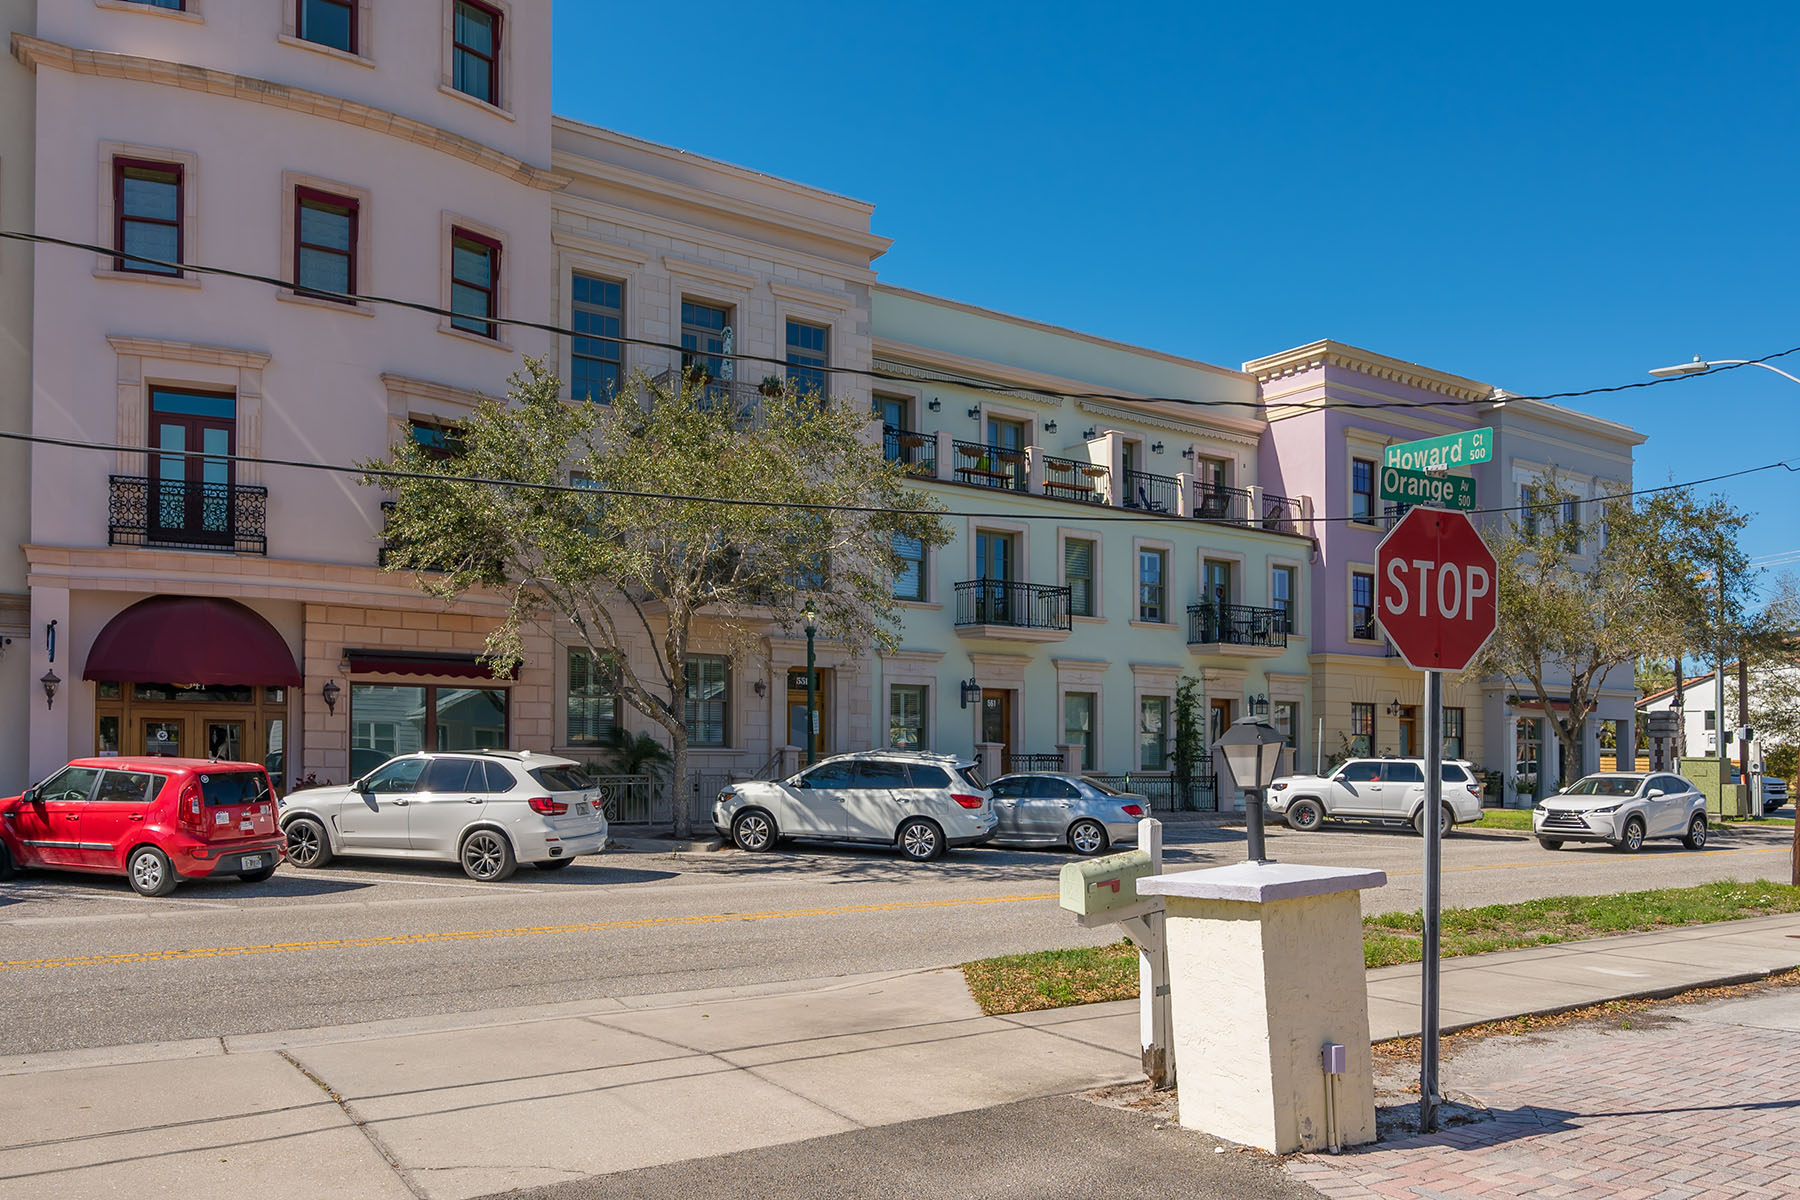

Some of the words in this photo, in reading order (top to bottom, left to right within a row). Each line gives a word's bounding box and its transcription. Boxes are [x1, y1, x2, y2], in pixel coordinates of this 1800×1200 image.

[1388, 438, 1462, 470] Howard
[1472, 433, 1483, 447] Ct
[1469, 448, 1486, 460] 500
[1384, 468, 1454, 502] Orange
[1460, 480, 1469, 491] Av
[1458, 494, 1471, 507] 500
[1384, 557, 1490, 621] STOP
